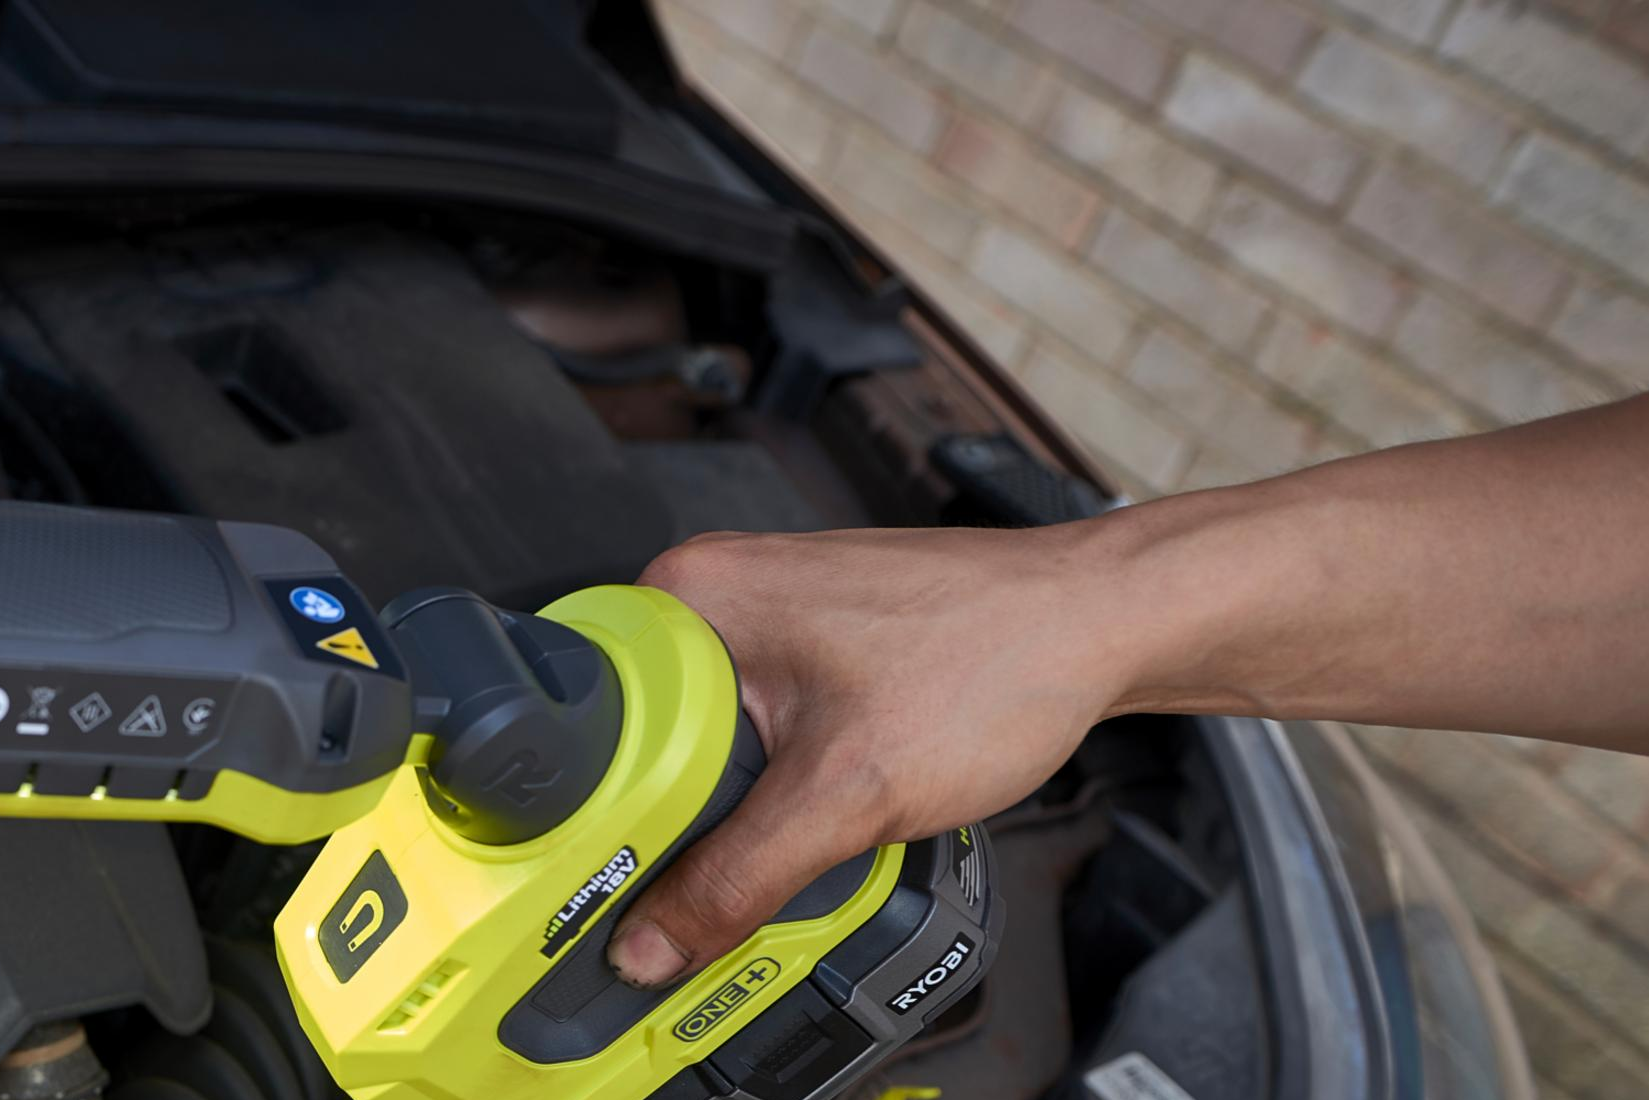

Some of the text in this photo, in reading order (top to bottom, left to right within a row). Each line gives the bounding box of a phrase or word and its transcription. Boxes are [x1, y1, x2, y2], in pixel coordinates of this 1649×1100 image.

[557, 849, 631, 921] Lithium
[601, 857, 636, 893] 18V
[892, 941, 969, 1010] RYOBI
